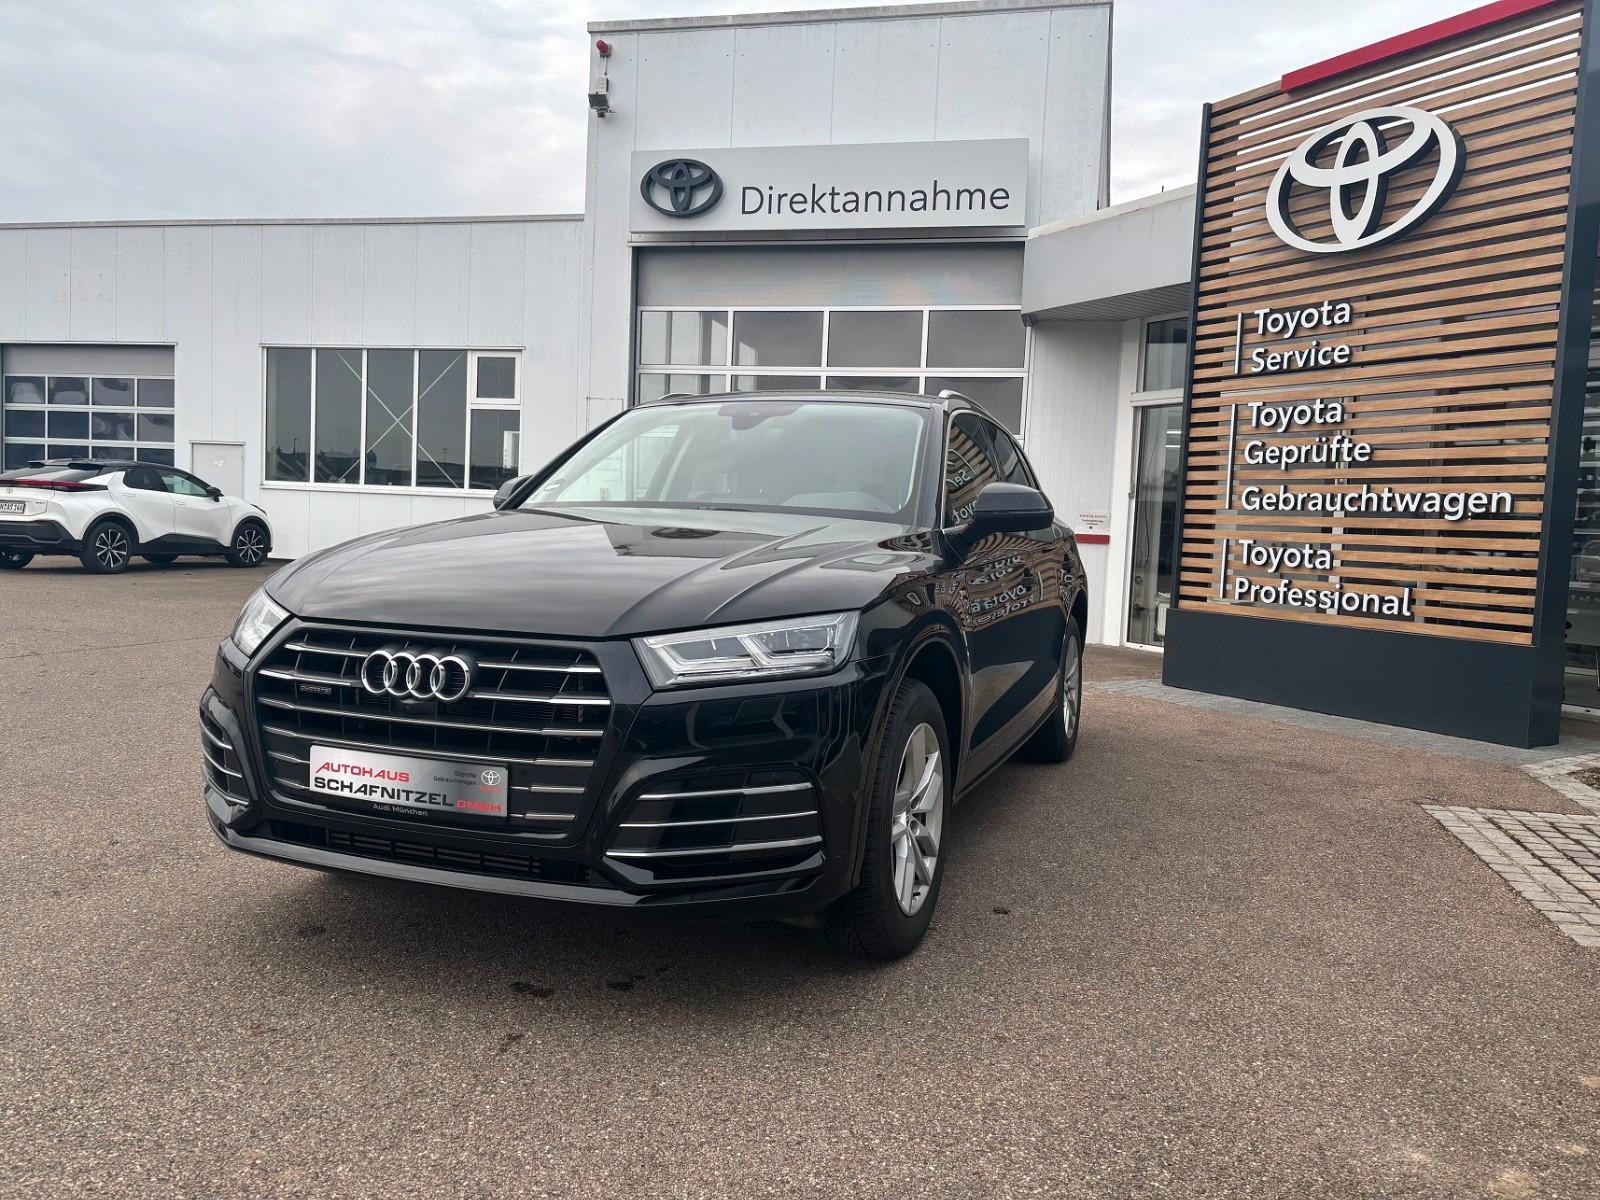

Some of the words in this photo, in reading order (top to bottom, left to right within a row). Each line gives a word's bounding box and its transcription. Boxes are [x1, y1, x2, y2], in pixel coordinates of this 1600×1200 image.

[741, 179, 1010, 215] Direktannahme
[1254, 300, 1352, 338] Toyota
[1250, 340, 1352, 373] Service
[1247, 398, 1344, 432] Toyota
[1243, 435, 1373, 469] Geprüfte
[1240, 484, 1513, 521] Gebrauchtwagen
[1238, 538, 1333, 573] Toyota
[1234, 577, 1412, 617] Professional
[315, 761, 410, 782] AUTOHAUS
[314, 776, 454, 807] SCHAFNITZEL
[373, 803, 391, 812] Audi
[392, 804, 429, 817] München
